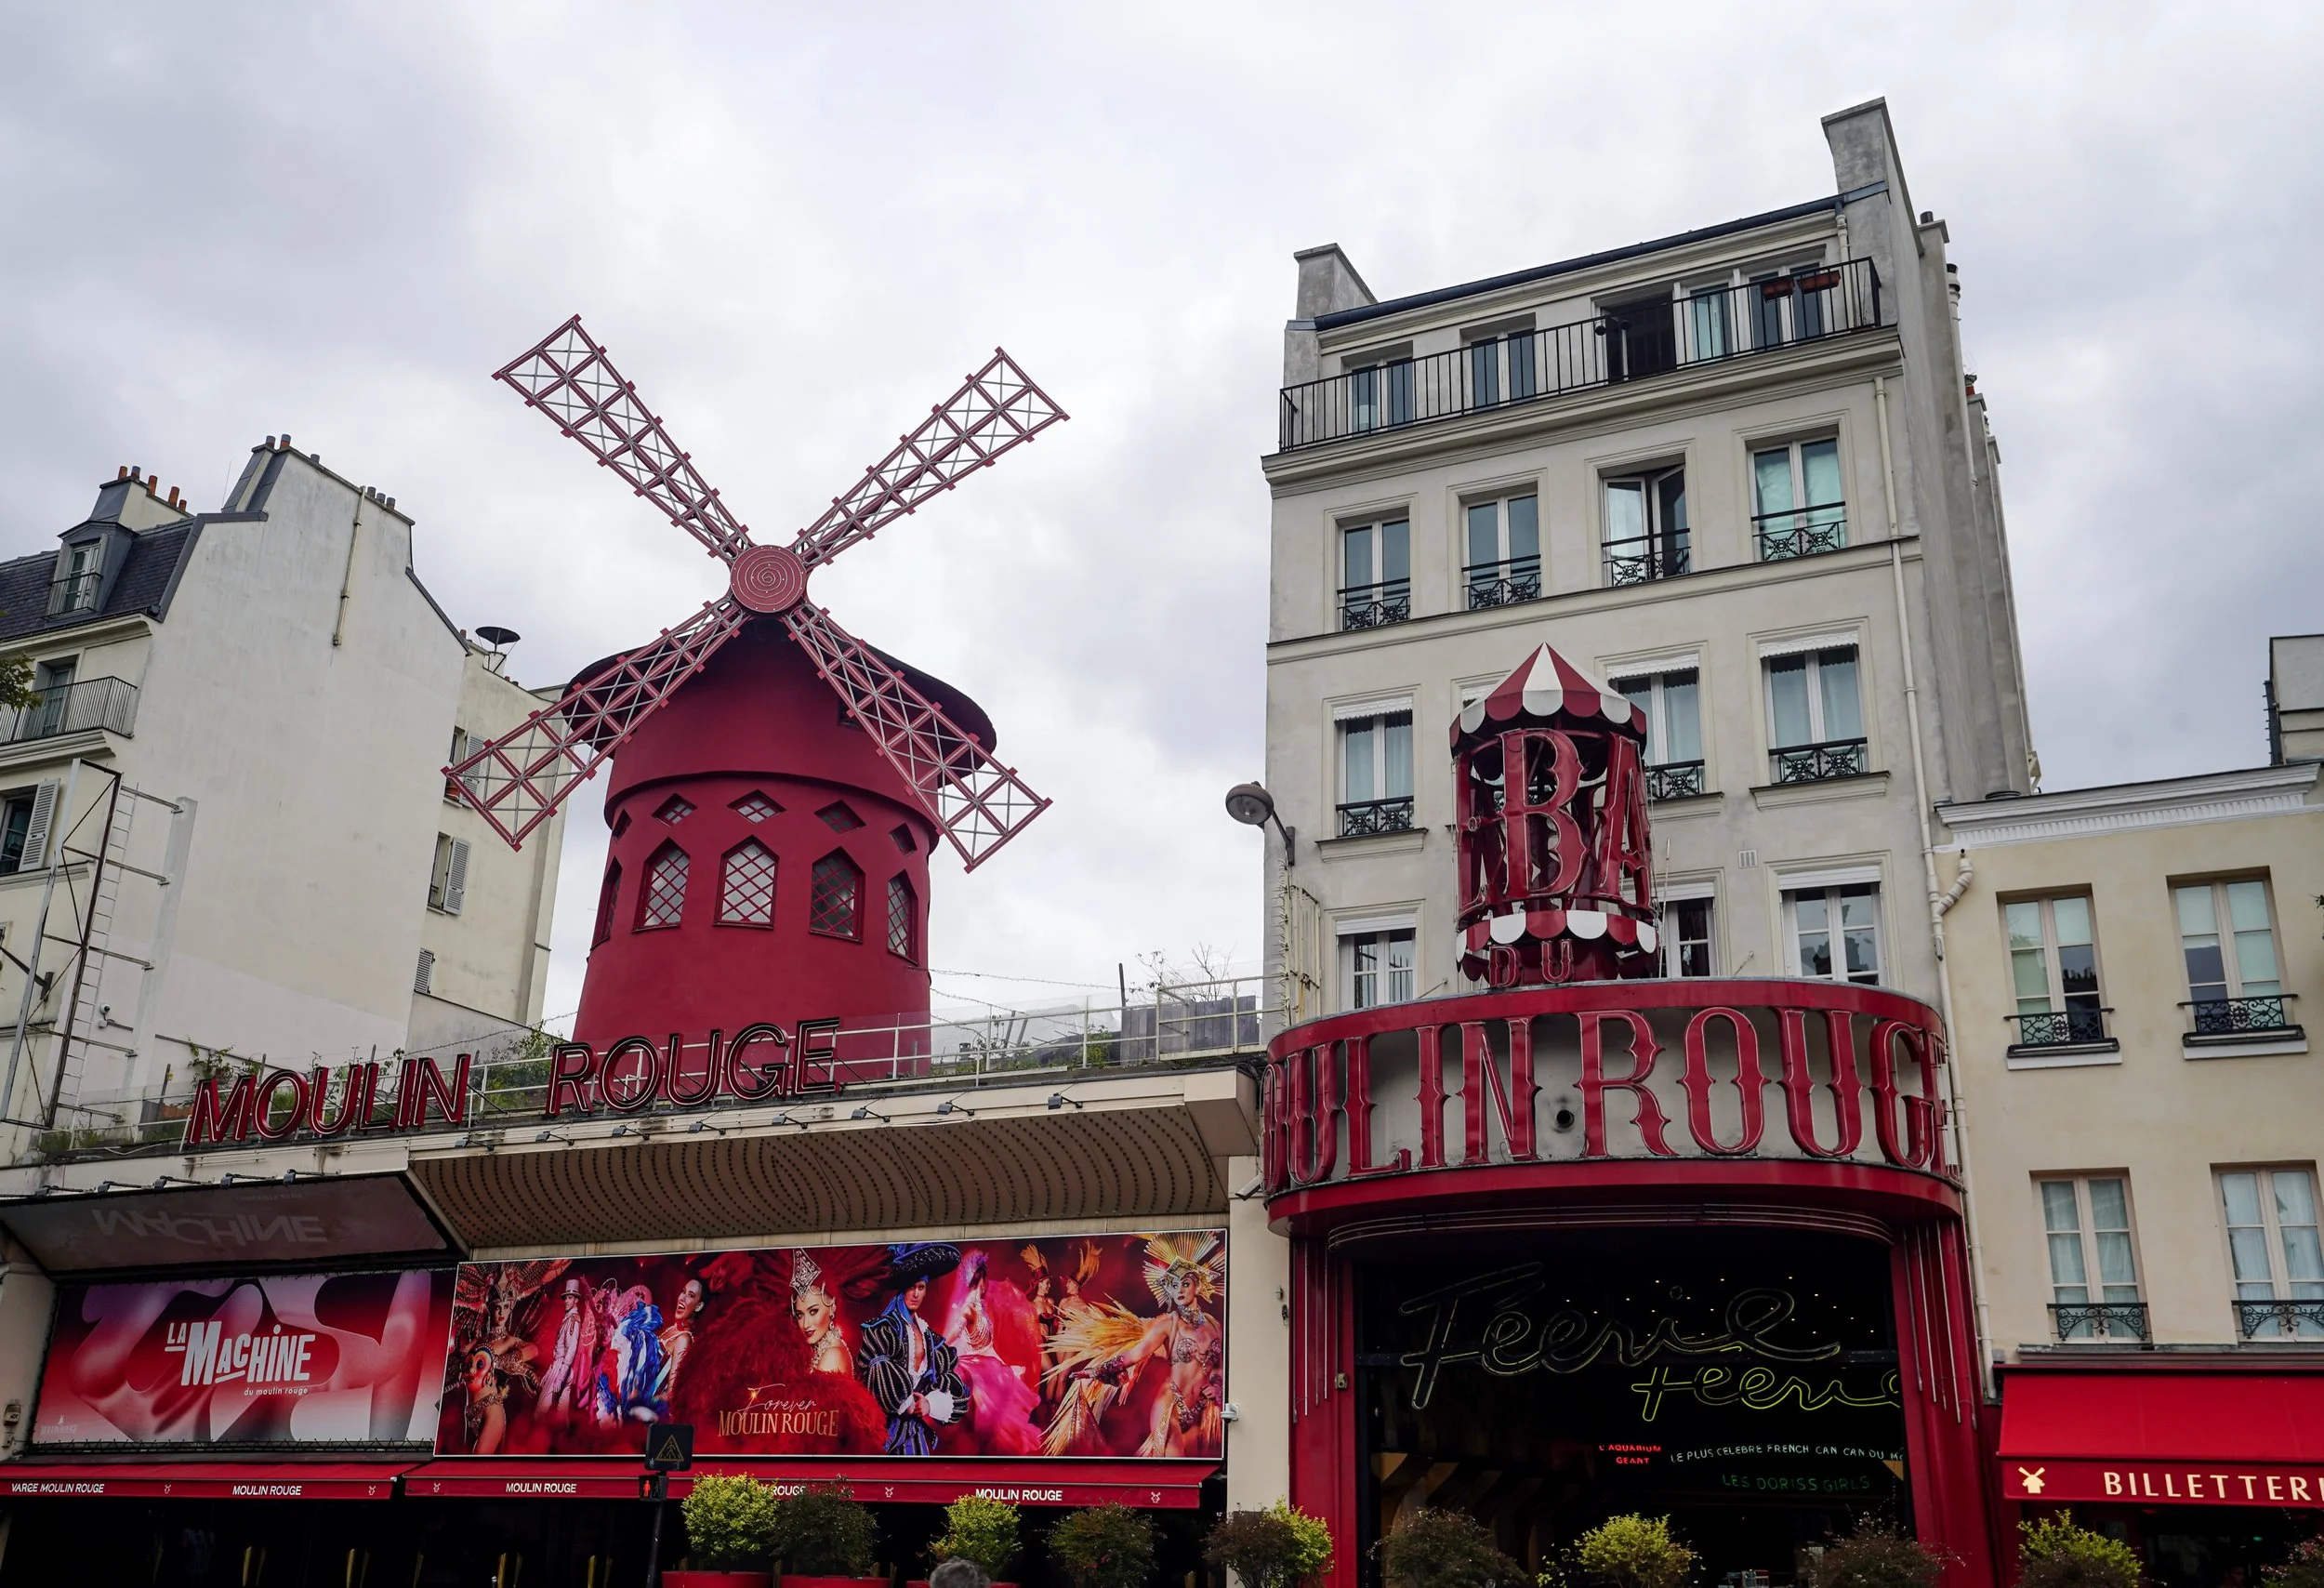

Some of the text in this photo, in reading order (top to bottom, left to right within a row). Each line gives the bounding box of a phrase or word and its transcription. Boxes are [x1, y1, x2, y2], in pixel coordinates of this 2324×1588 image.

[1488, 937, 1575, 988] DU
[187, 1016, 840, 1146] MOULIN ROUGE
[167, 1322, 187, 1344] LA
[244, 1385, 309, 1396] du moulin rouge
[736, 1383, 816, 1421] Forever
[718, 1409, 839, 1437] MOULIN ROUGE
[1616, 1456, 1650, 1465] GEANT
[1670, 1452, 1684, 1462] LE
[1686, 1449, 1714, 1461] PLUS
[1766, 1444, 1810, 1454] FRENCH
[1815, 1446, 1838, 1455] CAN
[1842, 1448, 1865, 1457] CAN
[1868, 1449, 1884, 1460] DU
[40, 1483, 74, 1493] MOULIN
[74, 1483, 105, 1493] ROUGE
[231, 1485, 302, 1496] MOULIN ROUGE
[505, 1482, 576, 1493] MOULIN ROUGE
[1723, 1474, 1750, 1489] LES
[1757, 1476, 1818, 1491] DORISS
[975, 1488, 1063, 1502] MOULIN ROUGE
